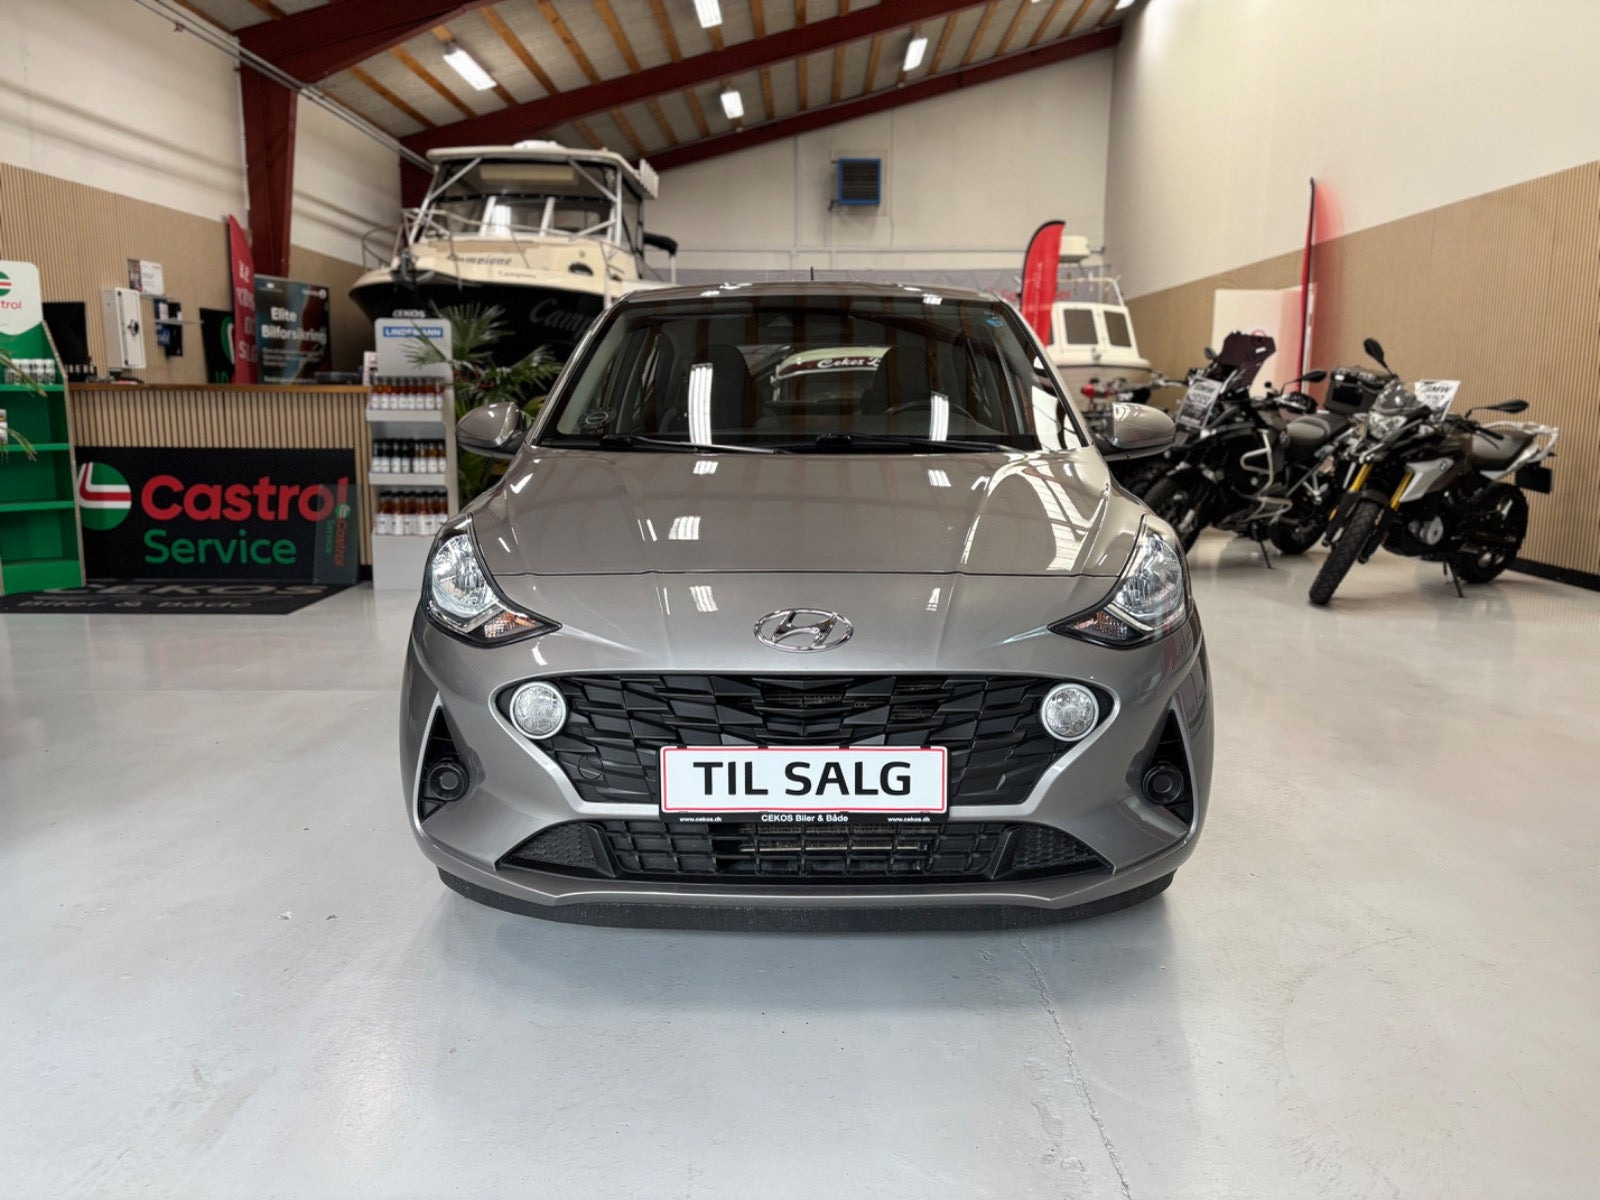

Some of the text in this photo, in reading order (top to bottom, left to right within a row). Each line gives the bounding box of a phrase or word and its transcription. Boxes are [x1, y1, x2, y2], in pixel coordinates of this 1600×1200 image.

[0, 300, 22, 310] trol
[270, 306, 297, 321] Elite
[817, 357, 864, 368] Cekos
[141, 475, 350, 522] Castrol
[144, 529, 297, 565] Service
[693, 761, 911, 796] TIL SALG
[761, 813, 849, 822] CEKOS Biler & Både
